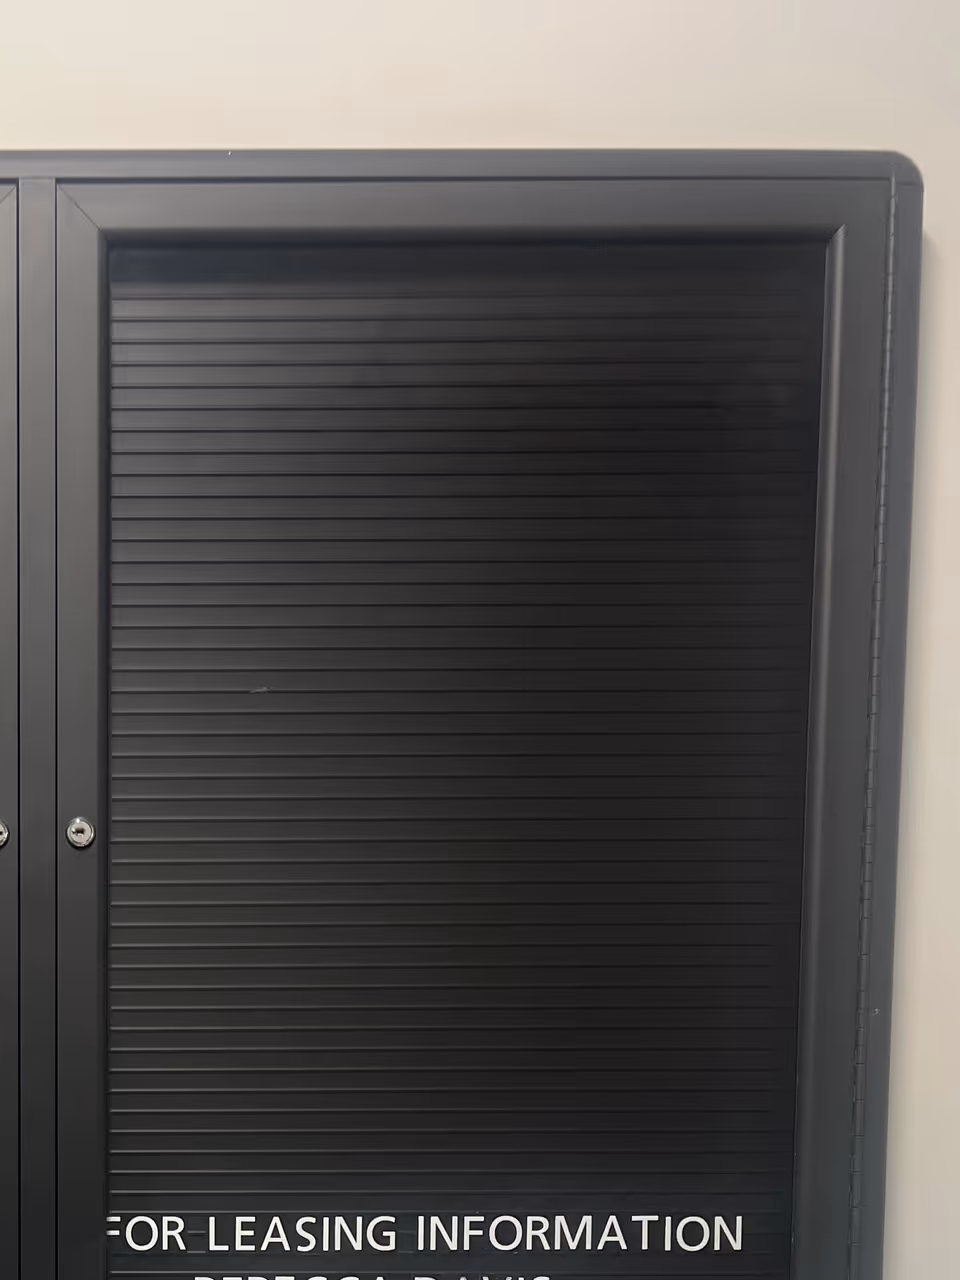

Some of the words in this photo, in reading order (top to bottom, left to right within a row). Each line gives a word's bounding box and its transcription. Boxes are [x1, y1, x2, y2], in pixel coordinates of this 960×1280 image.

[106, 1216, 186, 1251] FOR
[209, 1216, 395, 1251] LEASING
[418, 1216, 742, 1251] INFORMATION
